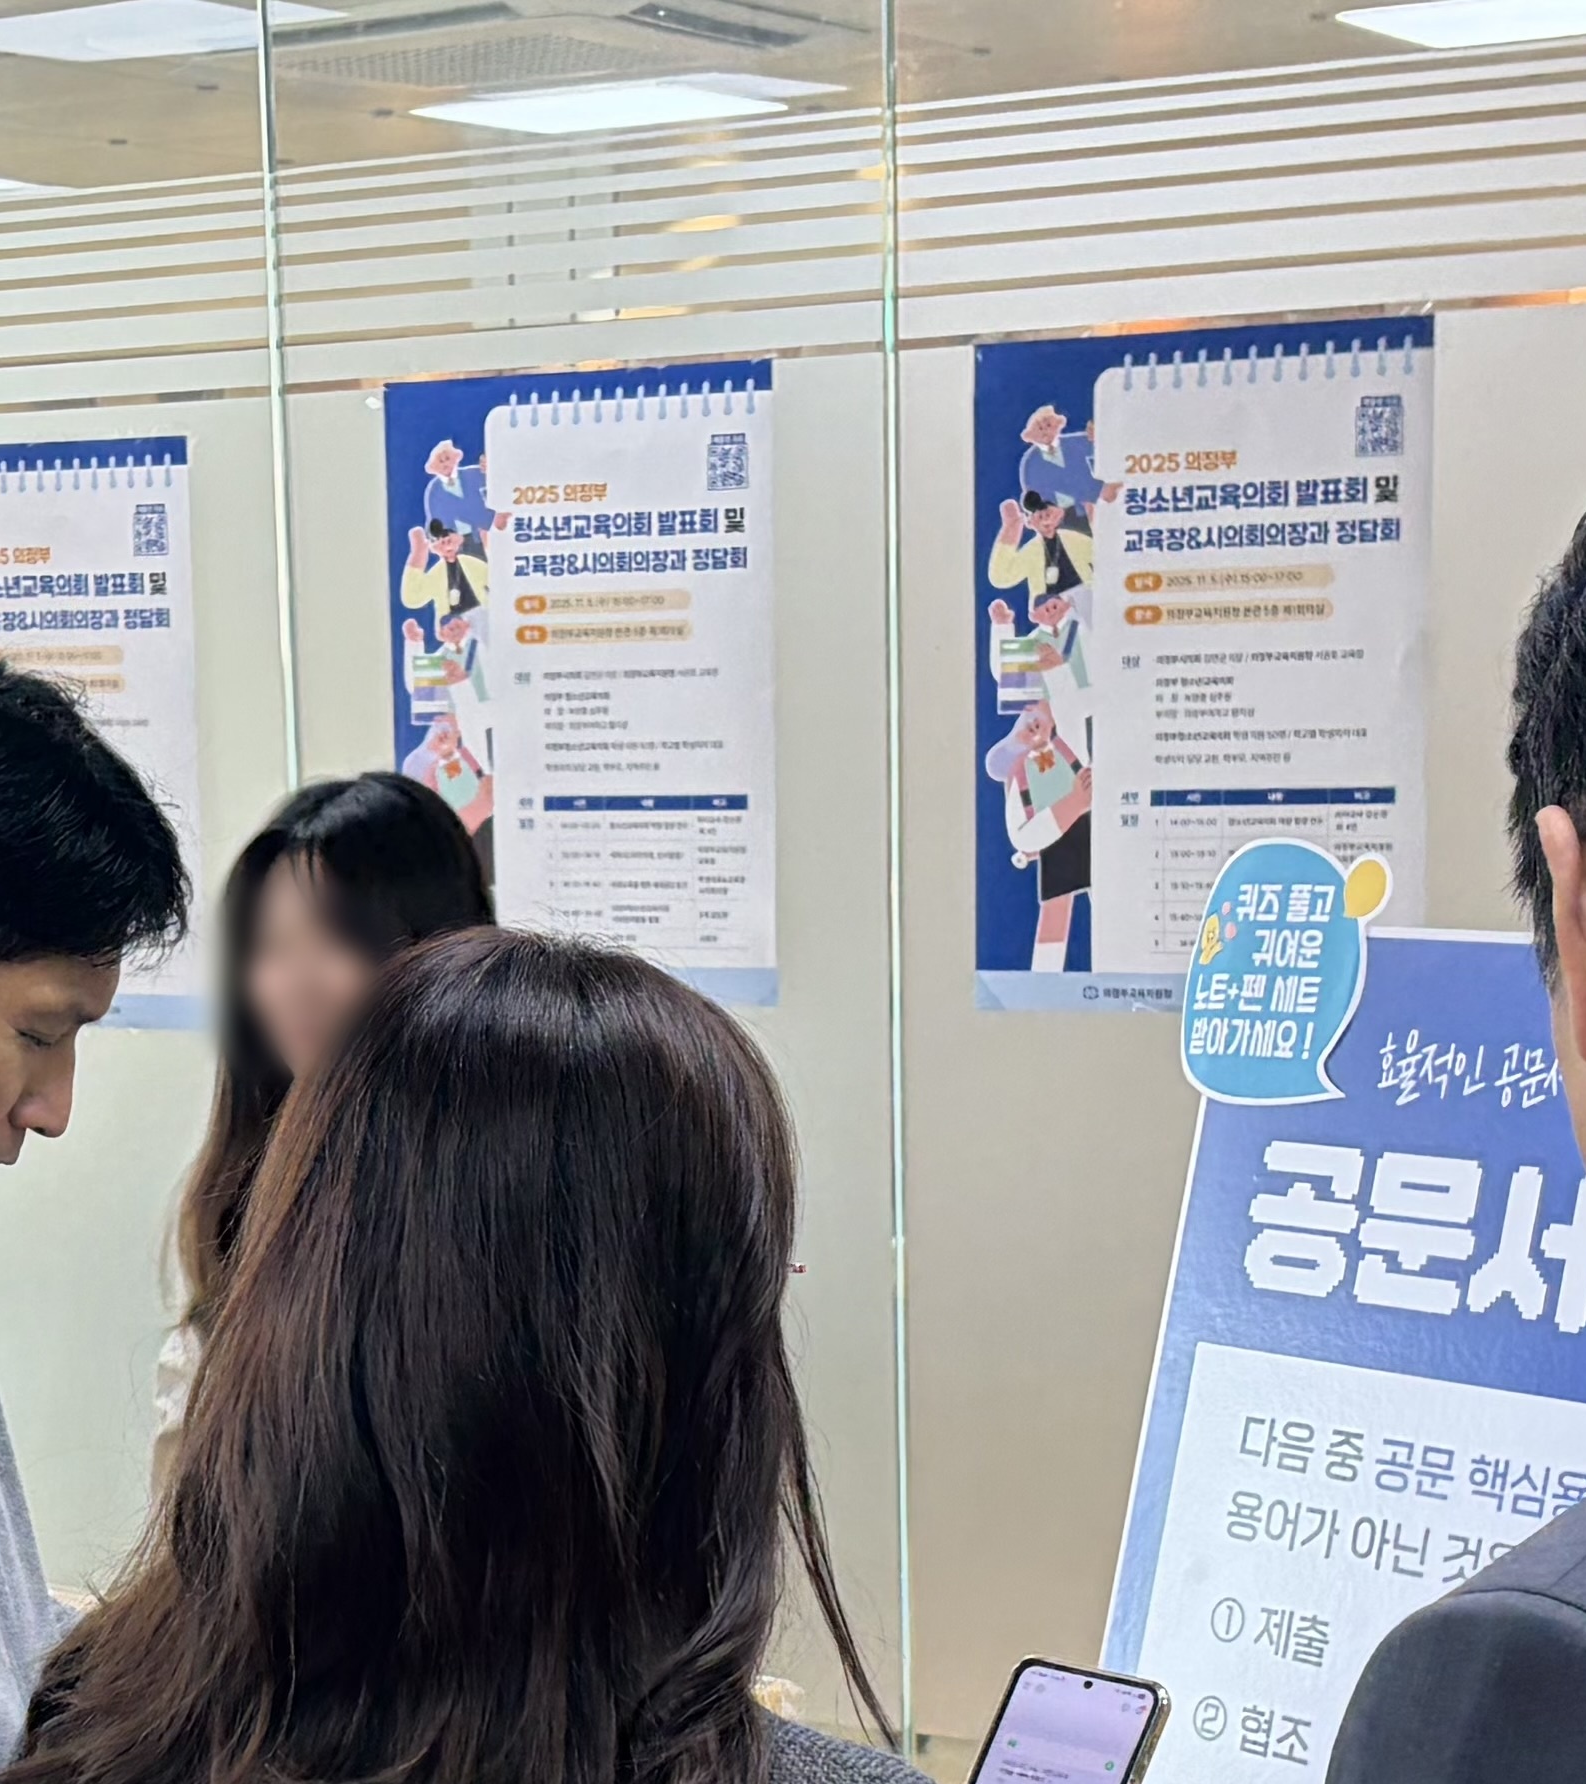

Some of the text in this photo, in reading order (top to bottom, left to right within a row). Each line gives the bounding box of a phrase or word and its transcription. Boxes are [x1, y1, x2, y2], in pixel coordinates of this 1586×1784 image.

[1124, 451, 1238, 474] 2025 의정부
[512, 482, 608, 505] 2025 의정부
[1124, 474, 1399, 516] 청소년교육의회 발표회 및
[514, 507, 745, 543] 청소년교육의회 발표회 및
[1124, 518, 1401, 553] 교육장&시의회의장과 정담회
[514, 546, 748, 577] 교육장&시의회의장과 정담회
[1235, 883, 1336, 923] 퀴즈 풀고
[1251, 929, 1324, 968] 귀여운
[1193, 973, 1322, 1013] 노트+펜 세트
[1377, 1029, 1486, 1106] 효율적인
[1238, 1415, 1316, 1475] 다음
[1324, 1428, 1365, 1483] 중
[1374, 1436, 1455, 1501] 공문
[1225, 1490, 1341, 1559] 용어가
[1350, 1517, 1432, 1579] 아닌
[1253, 1606, 1331, 1668] 제출
[1238, 1704, 1313, 1767] 협조
